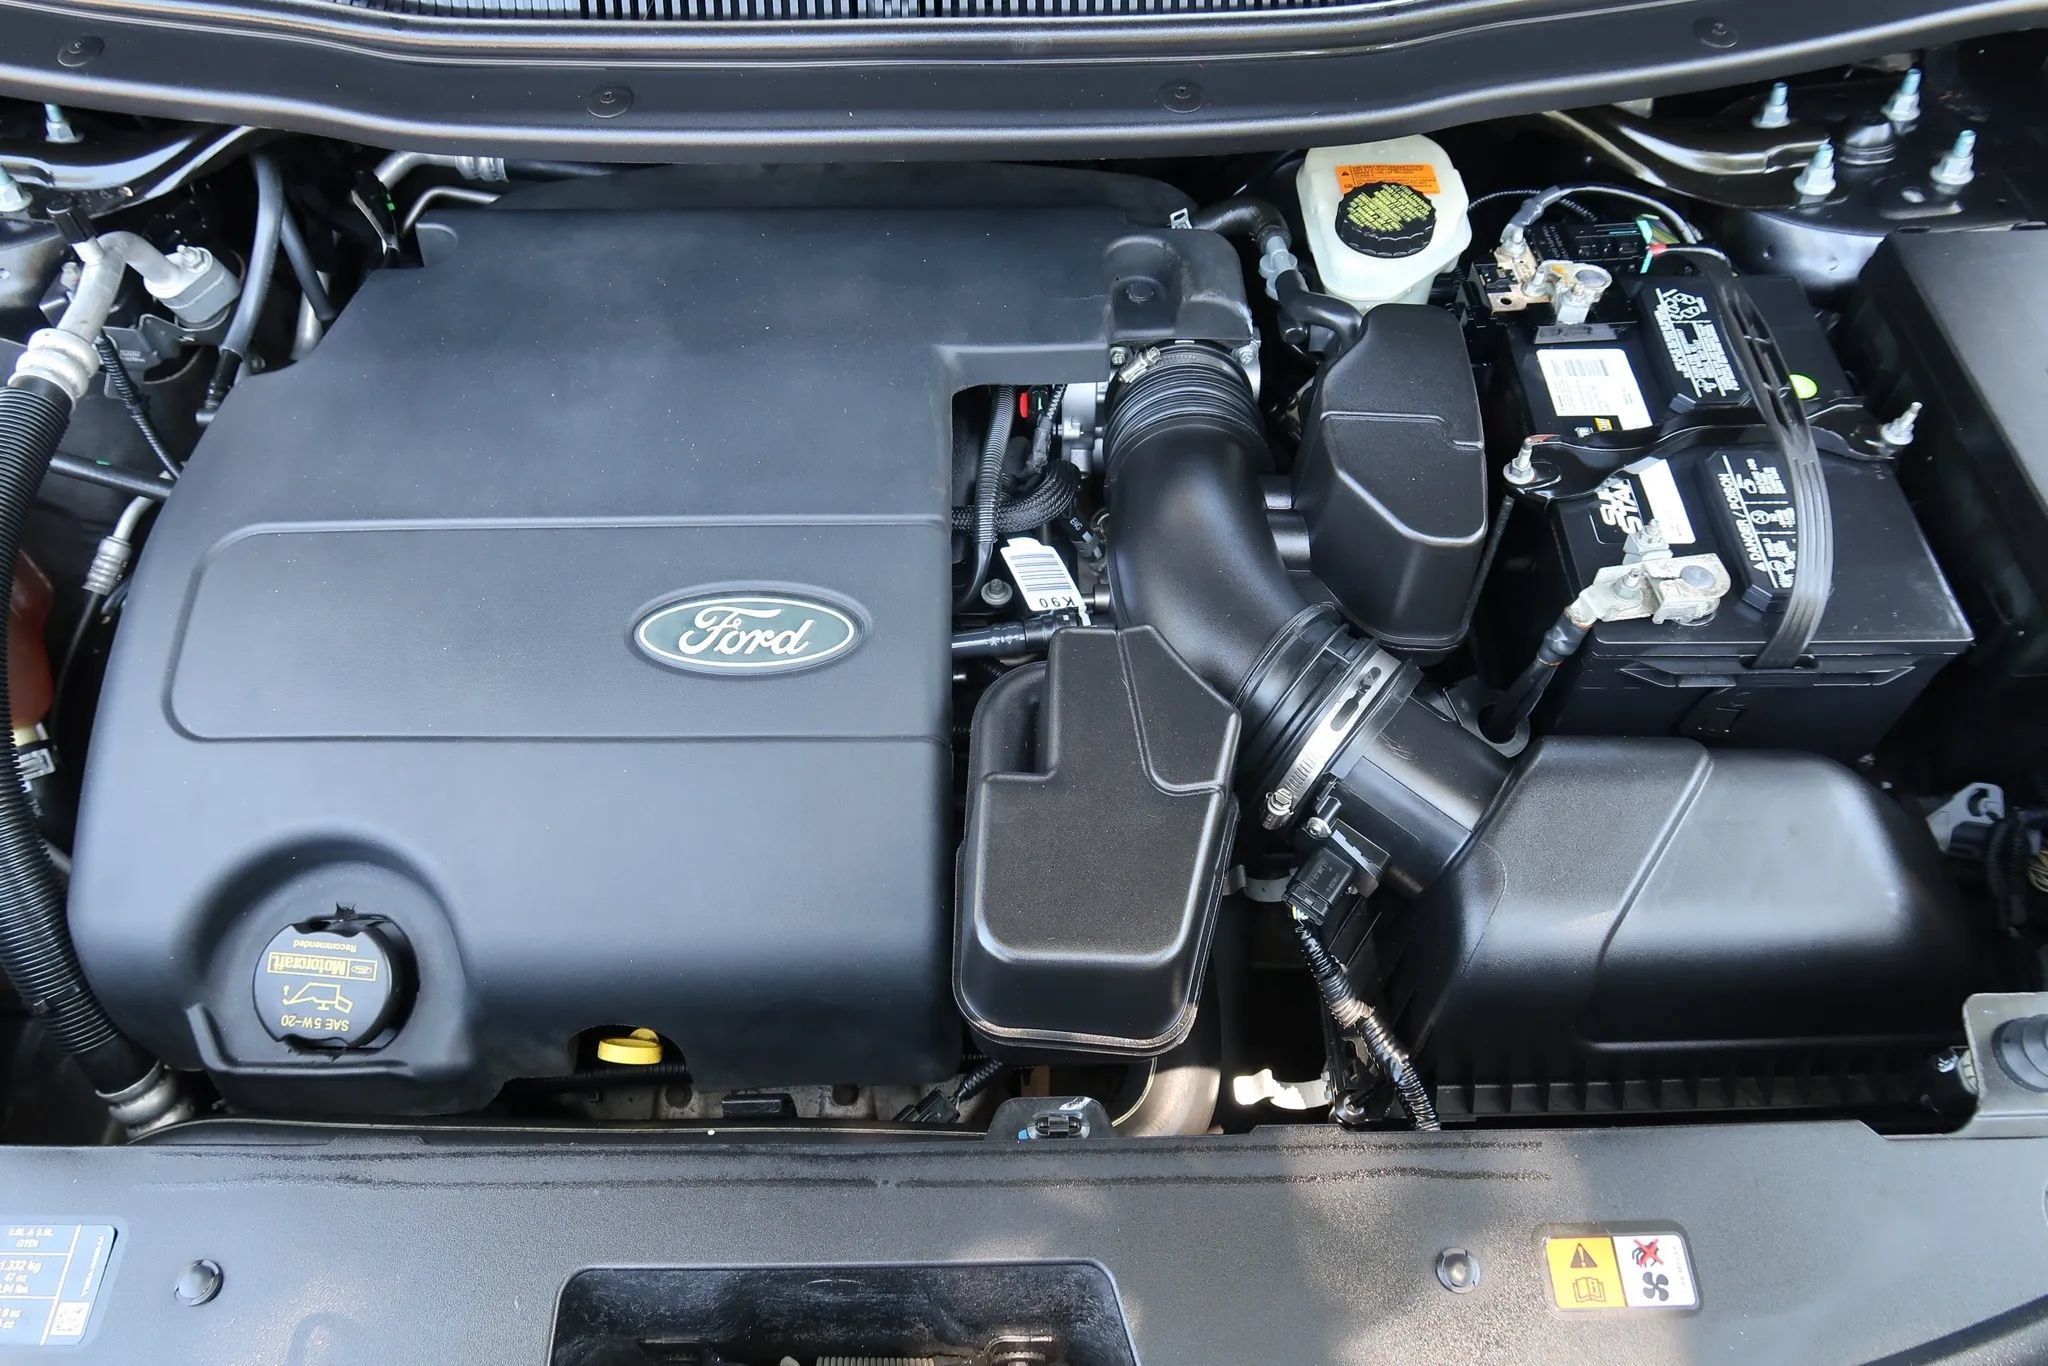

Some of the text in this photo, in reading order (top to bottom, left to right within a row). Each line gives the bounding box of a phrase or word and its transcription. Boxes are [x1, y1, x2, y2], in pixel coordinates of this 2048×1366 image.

[1717, 473, 1744, 510] POISON
[1735, 519, 1763, 561] DANGER
[1039, 596, 1075, 608] K90
[679, 606, 814, 654] Ford
[293, 940, 357, 953] Recommended
[273, 955, 347, 976] Motorcraft
[324, 1019, 350, 1032] SAE
